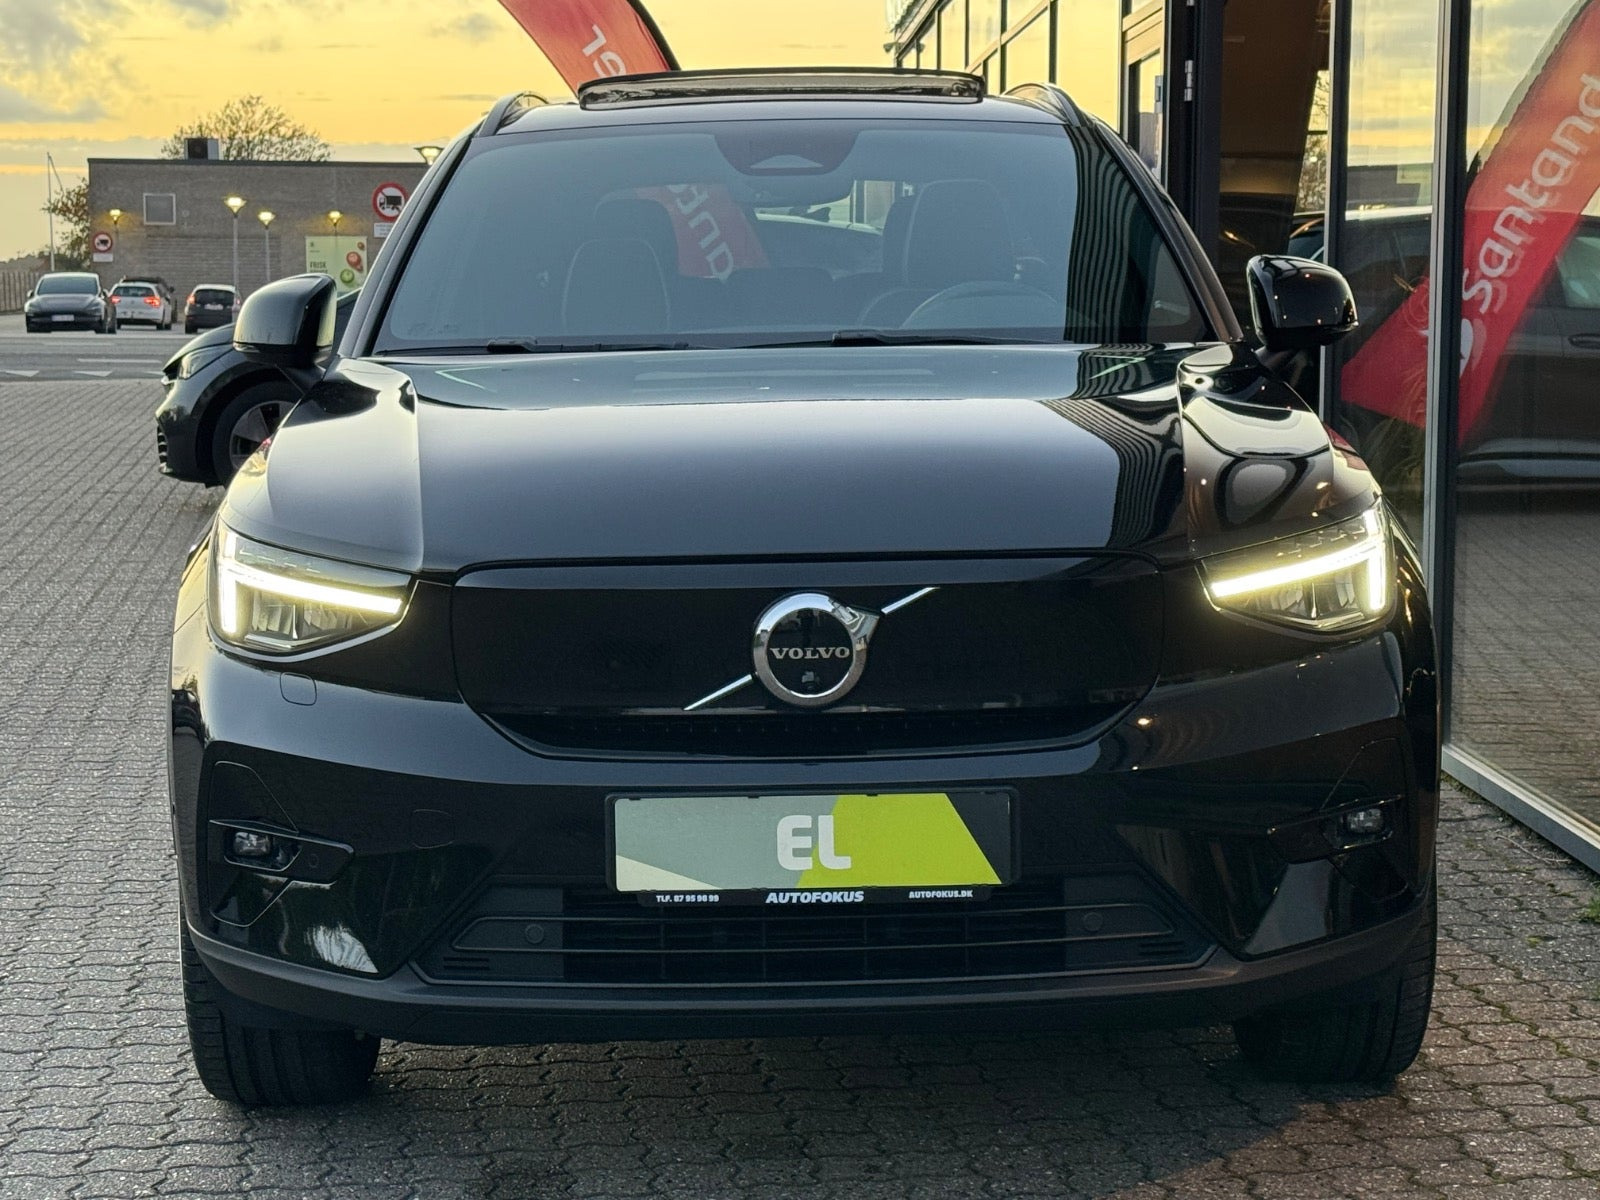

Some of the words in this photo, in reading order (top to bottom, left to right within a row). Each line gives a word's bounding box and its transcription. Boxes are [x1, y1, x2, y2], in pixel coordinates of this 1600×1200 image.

[770, 646, 850, 660] VOLVO
[776, 814, 852, 871] EL
[655, 894, 673, 903] TLF.
[765, 890, 865, 904] AUTOFOKUS
[908, 889, 974, 899] AUTOFOKUS.DK
